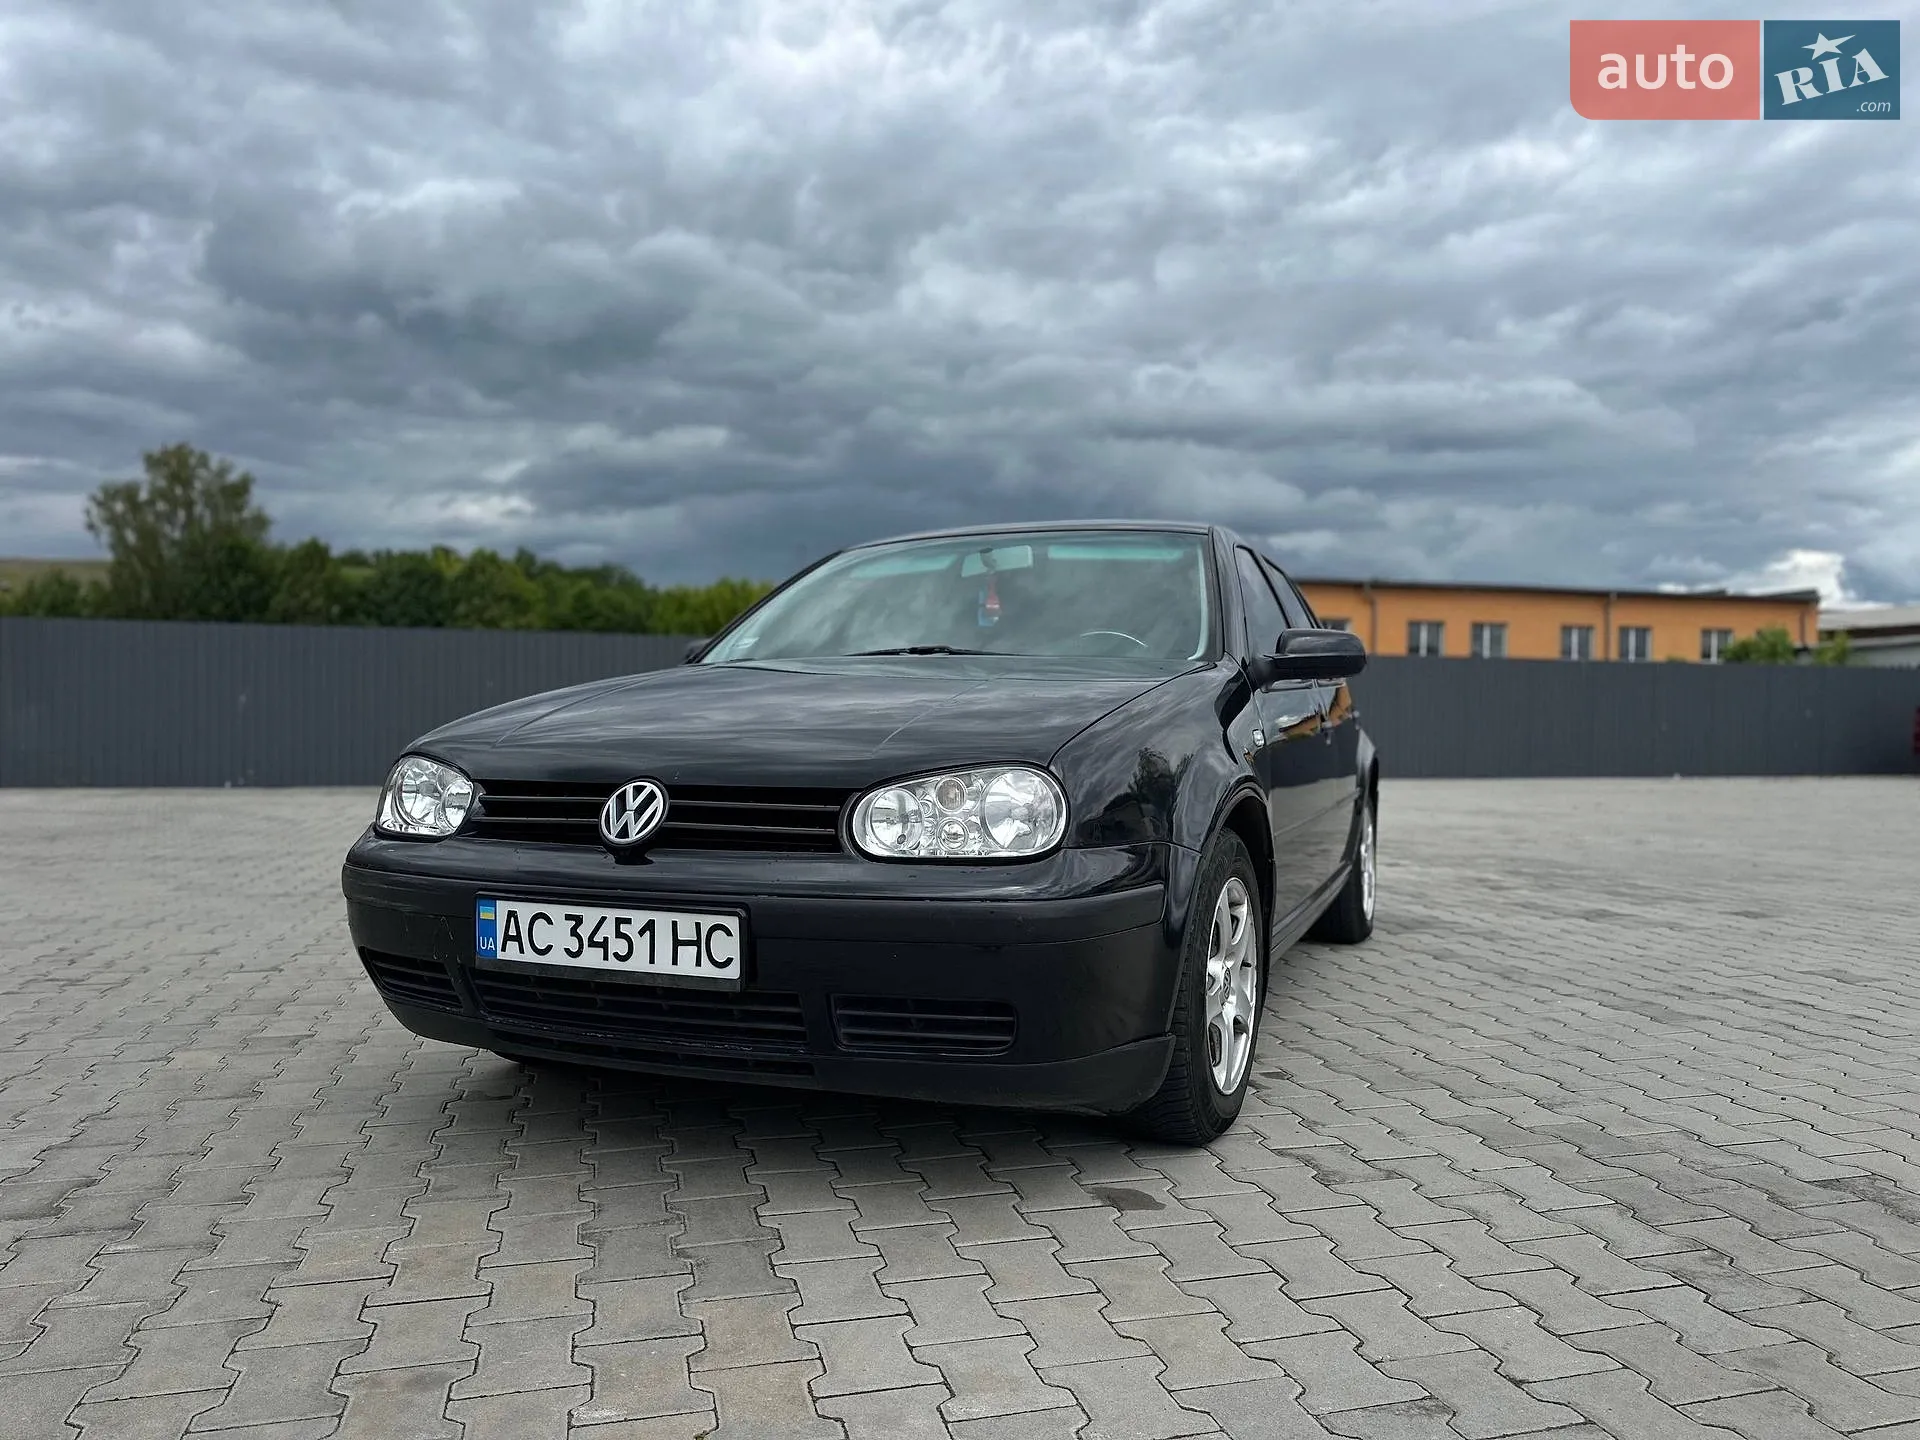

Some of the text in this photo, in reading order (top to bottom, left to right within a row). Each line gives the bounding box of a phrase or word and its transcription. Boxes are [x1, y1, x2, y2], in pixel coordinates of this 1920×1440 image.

[479, 936, 496, 951] UA
[500, 909, 734, 969] AC 3451 HC
